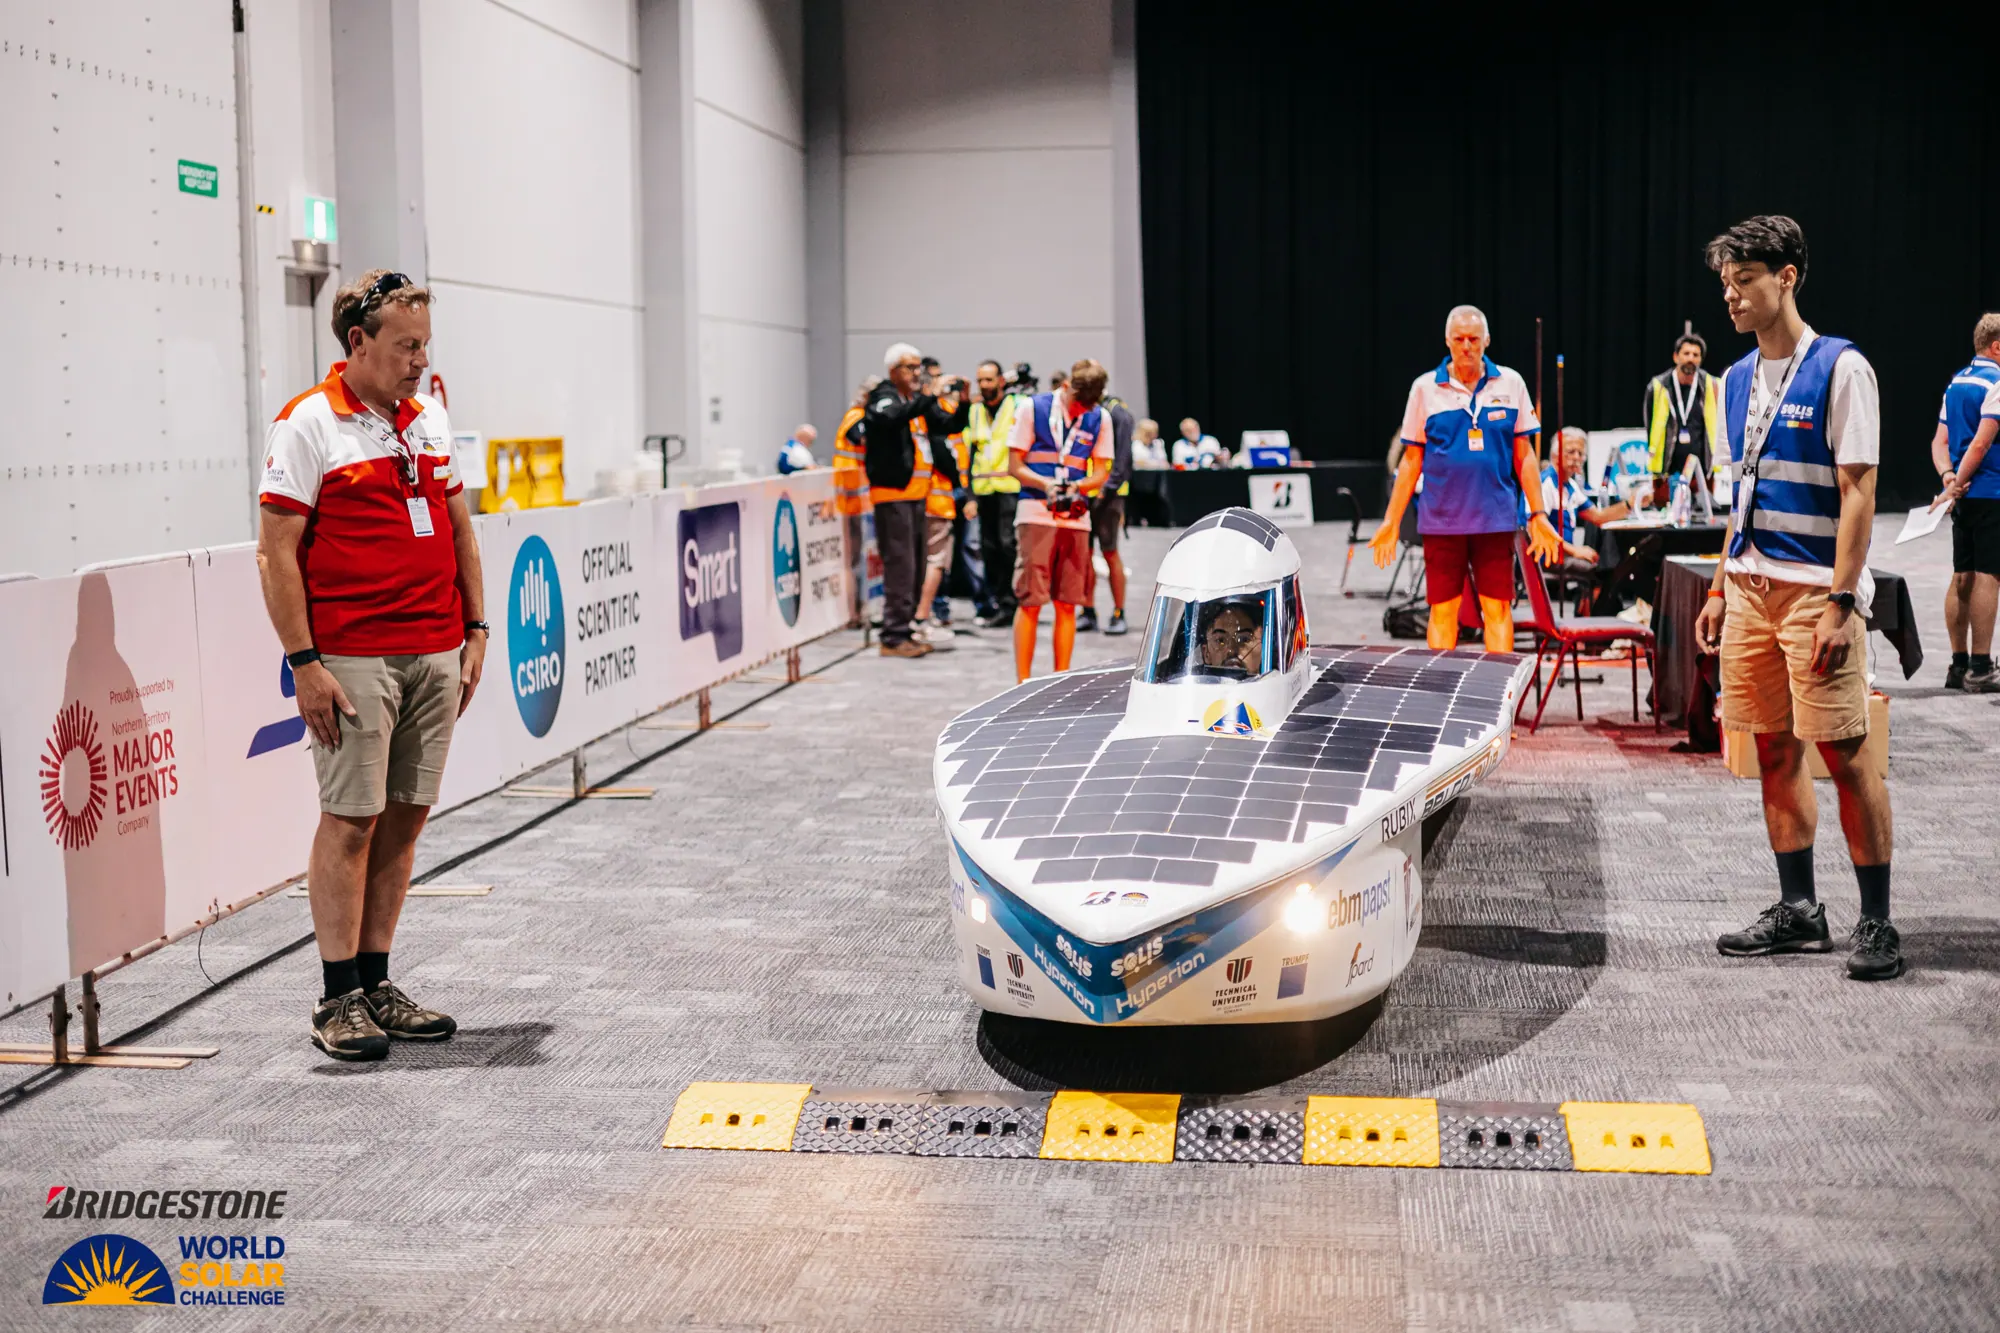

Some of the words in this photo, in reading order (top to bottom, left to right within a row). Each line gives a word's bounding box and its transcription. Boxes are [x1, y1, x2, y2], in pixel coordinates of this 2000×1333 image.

[1780, 403, 1814, 418] SOLIS
[582, 541, 633, 583] OFFICIAL
[684, 531, 738, 608] Smart
[577, 591, 640, 641] SCIENTIFIC
[109, 688, 134, 705] Proudly
[135, 681, 166, 699] supported
[167, 678, 174, 692] by
[517, 651, 561, 697] CSIRO
[585, 645, 636, 696] PARTNER
[112, 717, 143, 737] Northern
[143, 710, 171, 729] Territory
[113, 728, 175, 777] MAJOR
[115, 764, 178, 815] EVENTS
[117, 814, 149, 836] Company
[1381, 797, 1416, 843] RUBIX
[1056, 934, 1093, 978] SOLIS
[1111, 936, 1164, 977] SOLIS
[1282, 953, 1310, 967] TRUMPF
[1006, 978, 1033, 992] TECHNICAL
[1007, 987, 1035, 1001] UNIVERSITY
[1034, 943, 1095, 1015] Hyperion
[1115, 952, 1205, 1014] Hyperion
[1212, 992, 1258, 1007] UNIVERSITY
[1215, 984, 1257, 998] TECHNICAL
